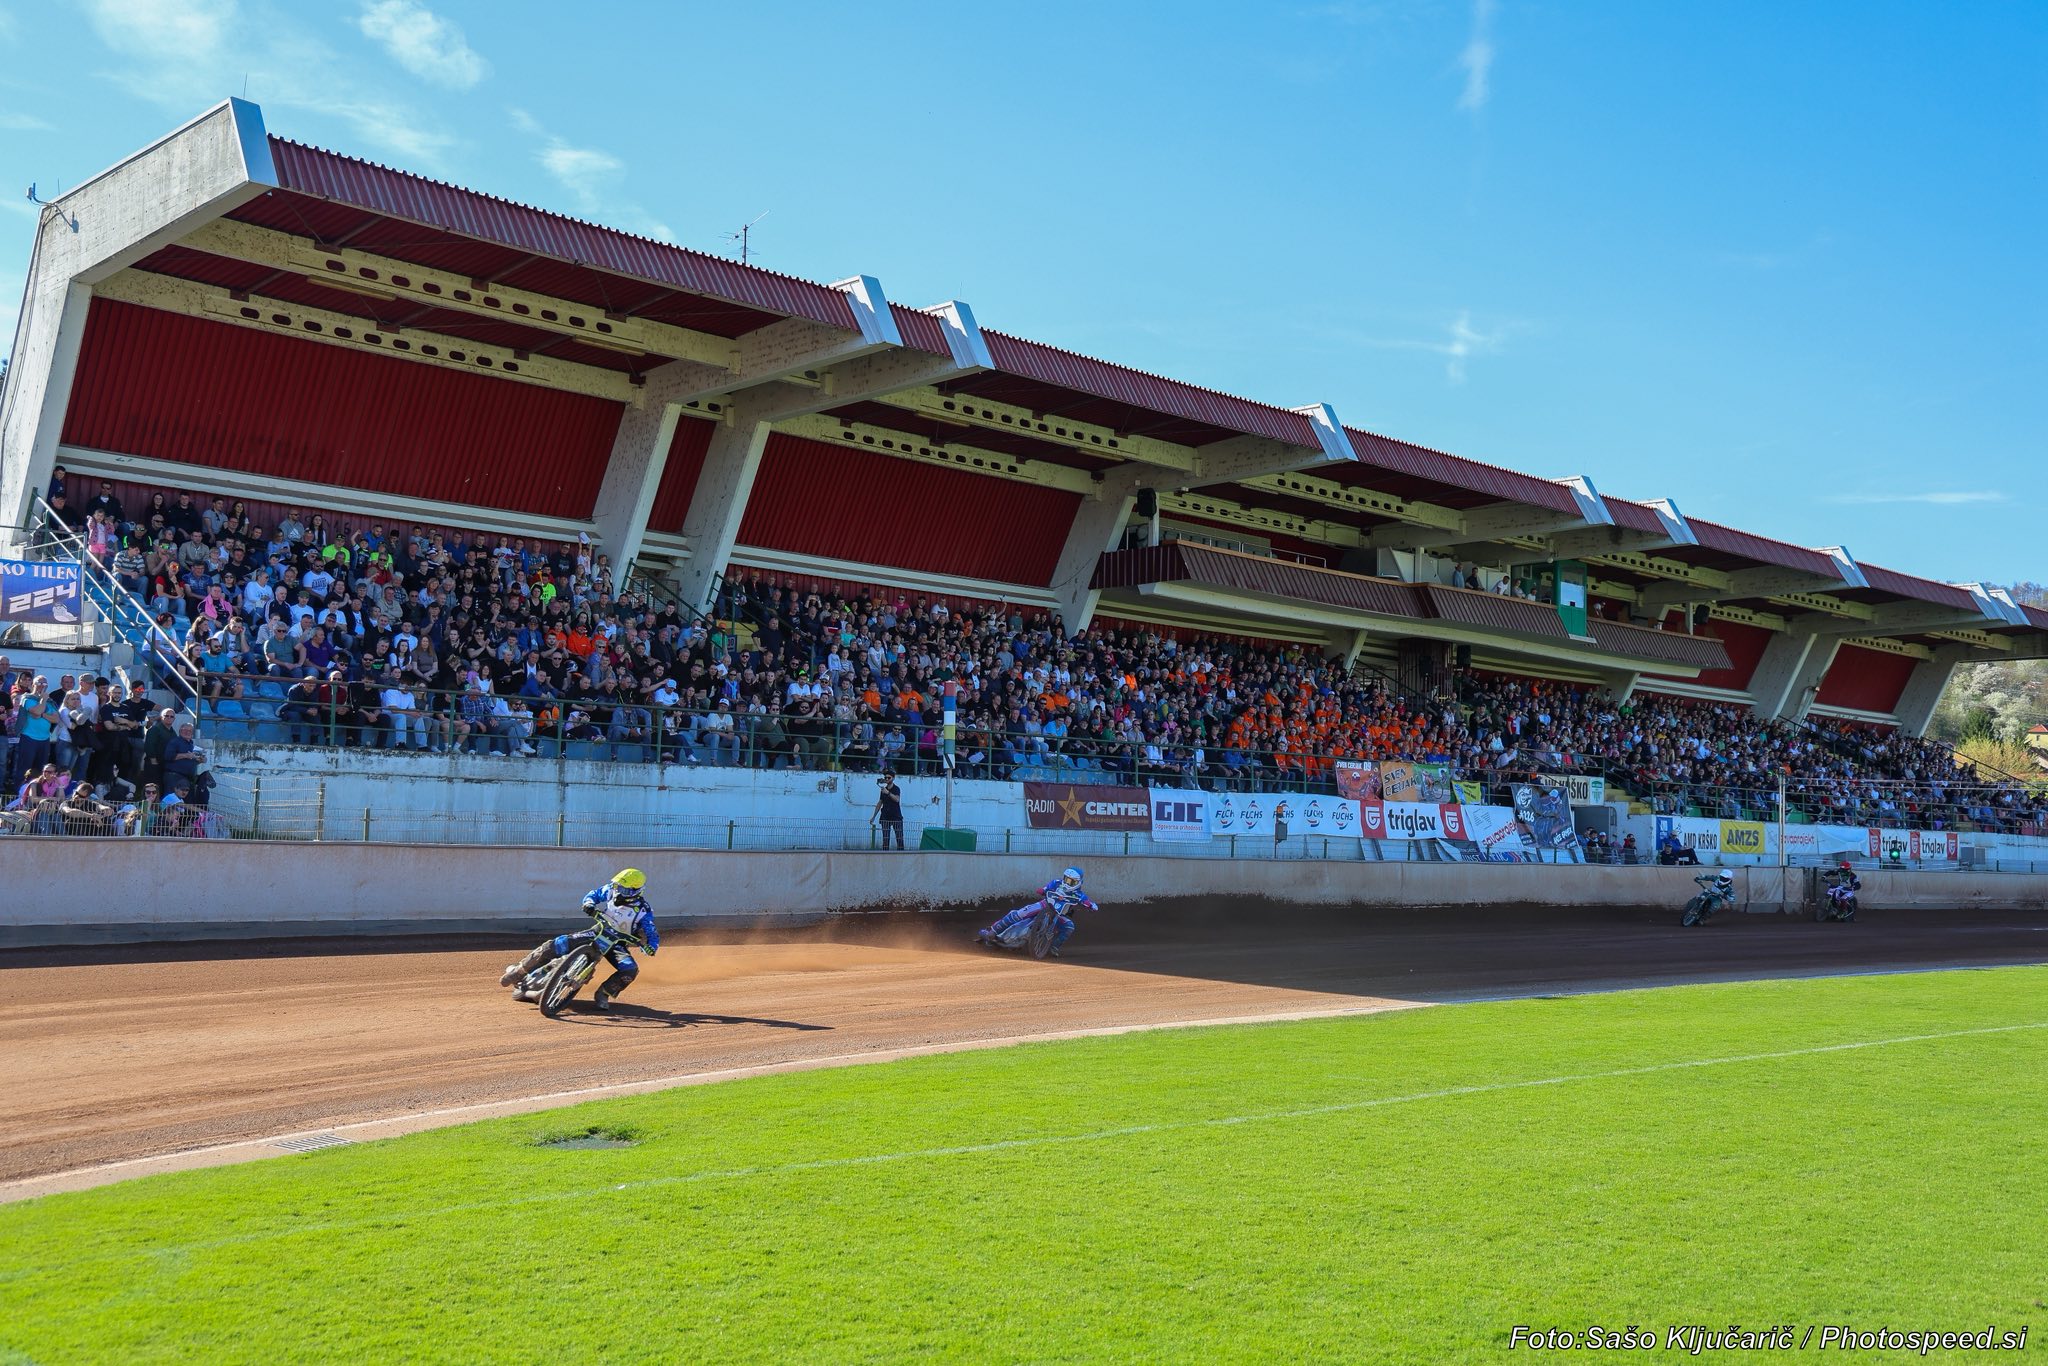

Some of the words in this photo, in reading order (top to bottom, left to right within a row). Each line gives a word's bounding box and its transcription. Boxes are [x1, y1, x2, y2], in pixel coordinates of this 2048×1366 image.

[31, 564, 77, 580] TILEN
[9, 581, 76, 614] 224
[1026, 799, 1055, 814] RADIO
[1085, 801, 1149, 817] CENTER
[1155, 801, 1203, 823] GIC
[1240, 810, 1263, 819] FUCHS
[1272, 810, 1295, 819] FCHS
[1332, 811, 1354, 820] FUCHS
[1388, 808, 1436, 837] triglav
[1684, 833, 1697, 849] AMD
[1698, 830, 1718, 849] KRŠKO
[1727, 829, 1759, 846] AMZS
[1922, 838, 1946, 858] triglav
